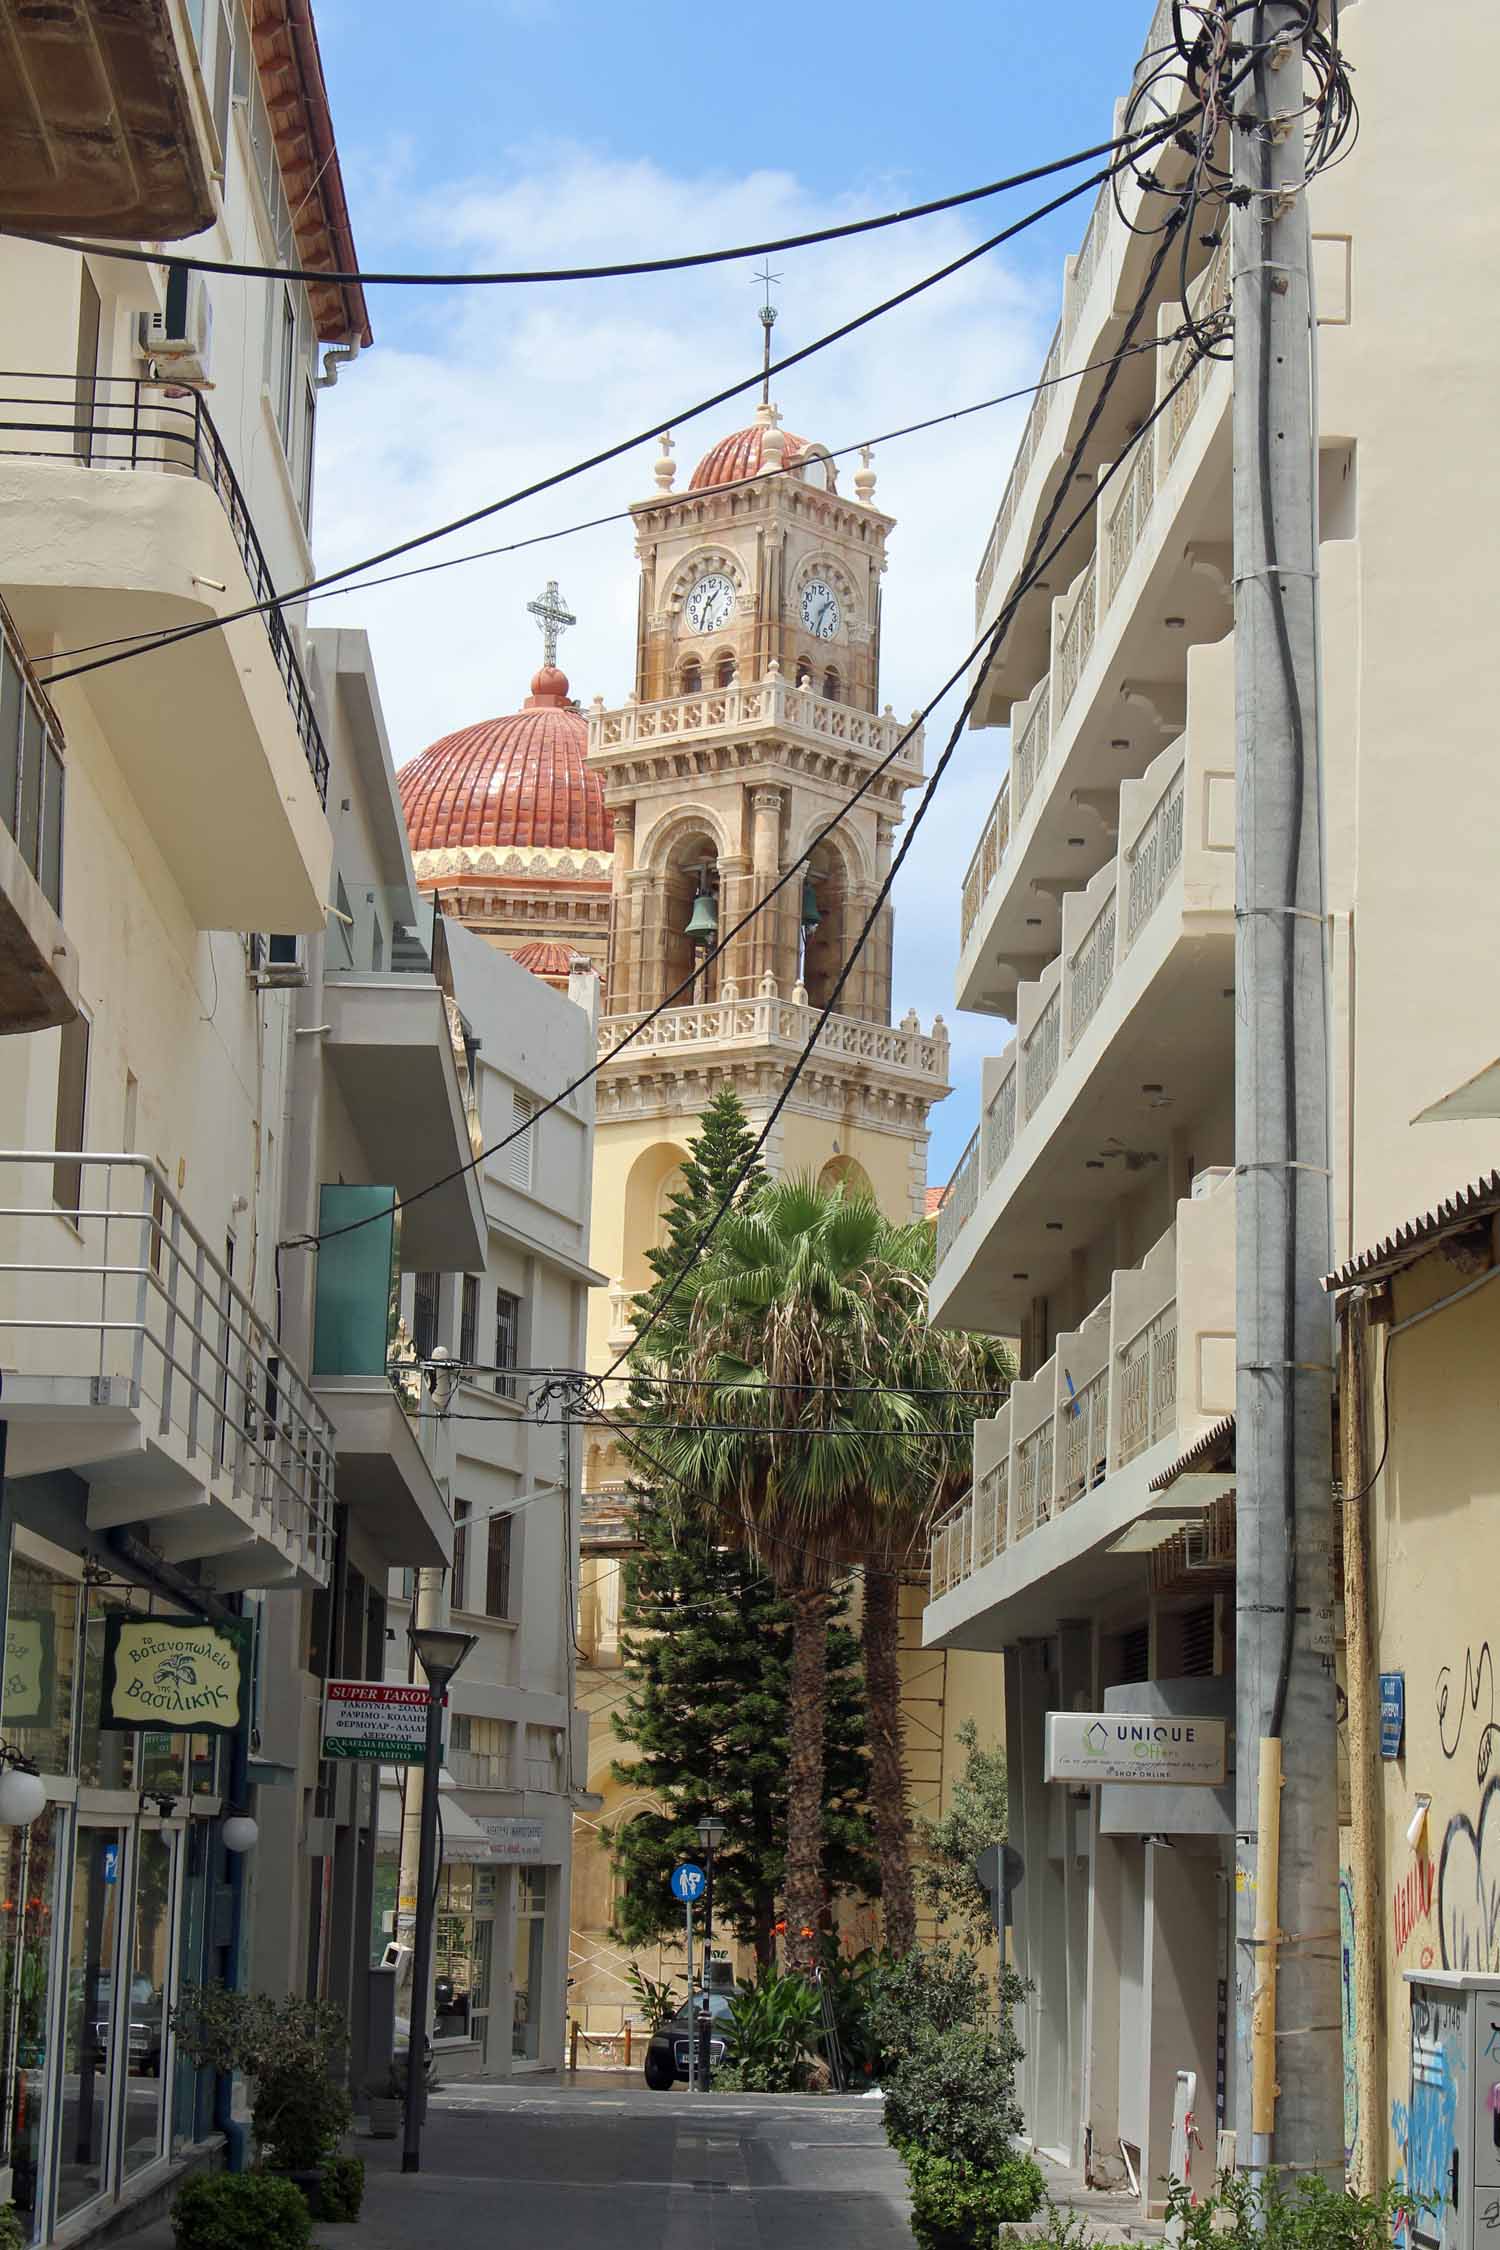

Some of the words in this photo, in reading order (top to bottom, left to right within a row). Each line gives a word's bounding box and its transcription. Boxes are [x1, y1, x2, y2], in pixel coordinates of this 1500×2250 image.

[701, 584, 706, 593] 11
[708, 579, 716, 589] 12
[818, 585, 825, 596] 12
[691, 594, 702, 604] 10
[805, 591, 812, 602] 10
[128, 1640, 231, 1671] Βοτανοπωλείο
[125, 1677, 229, 1711] Βασιλικής
[331, 1687, 377, 1699] SUPER
[343, 1700, 391, 1711] ΤΑΚΟΥΝΙΑ
[340, 1710, 380, 1719] ΡΑΨΙΜΟ
[336, 1720, 390, 1730] ΦΕΡΜΟΥΑΡ
[361, 1731, 412, 1741] ΑΞΕΣΟΥΑΡ
[1117, 1726, 1196, 1743] UNIQUE
